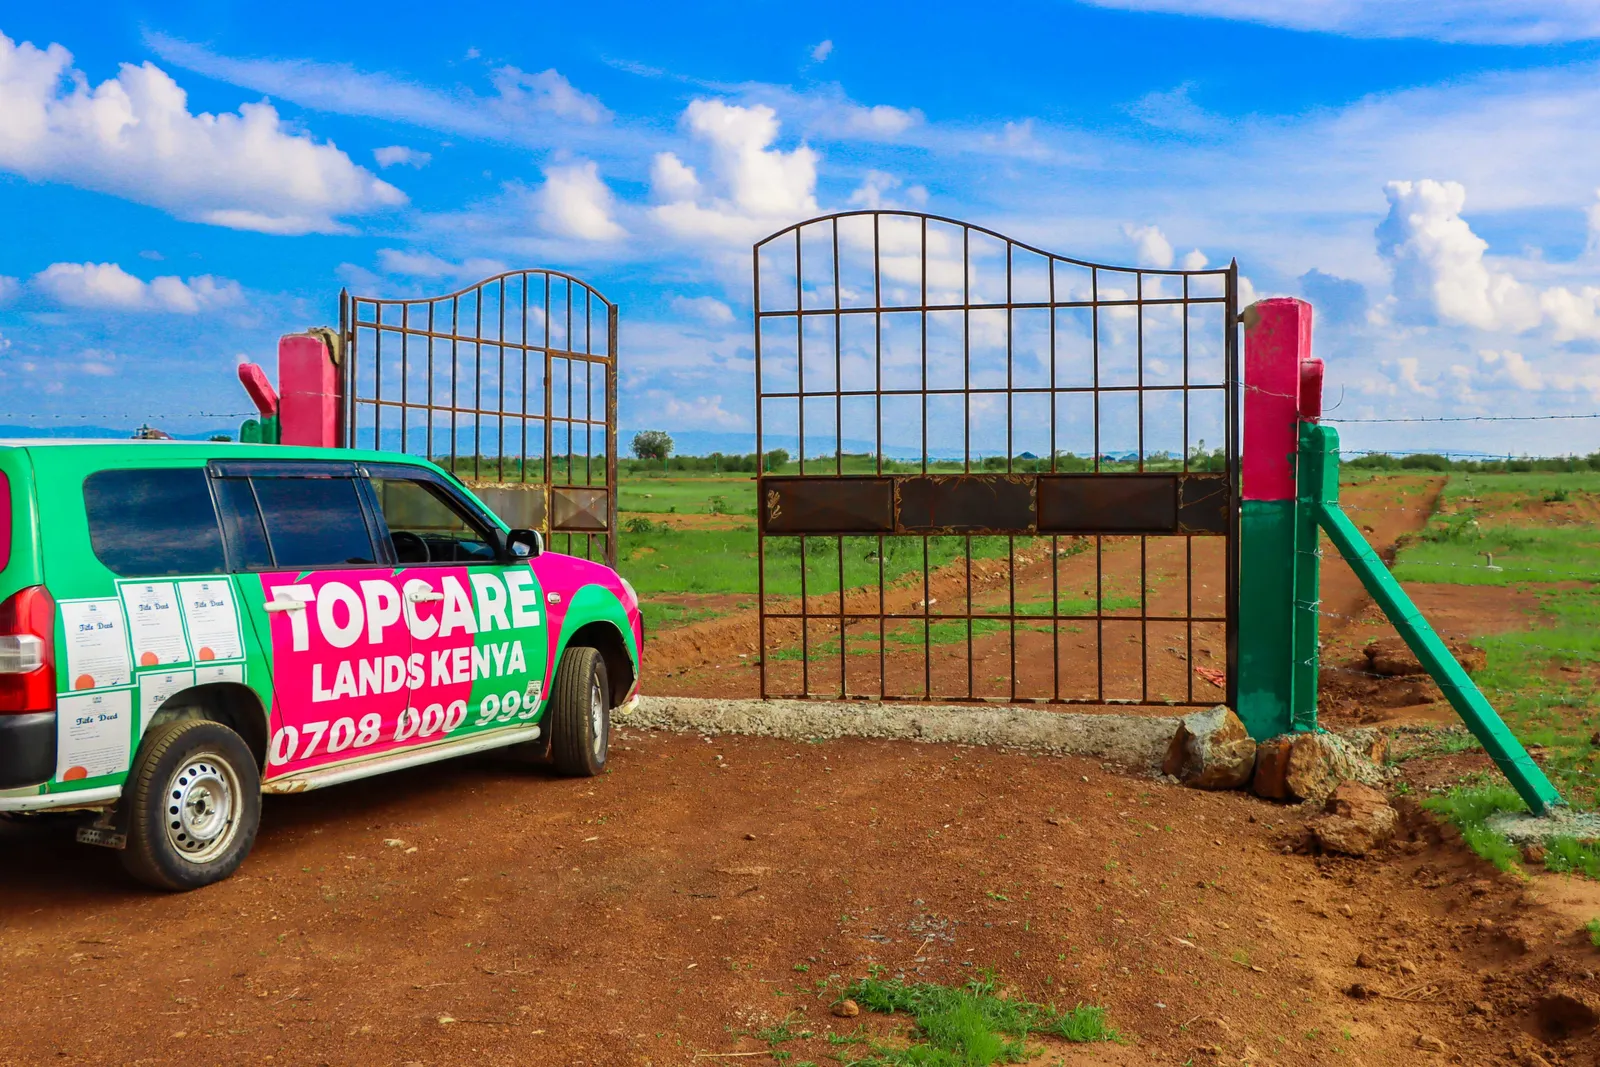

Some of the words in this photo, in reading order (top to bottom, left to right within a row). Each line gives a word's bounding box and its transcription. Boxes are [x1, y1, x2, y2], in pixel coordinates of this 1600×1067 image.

[270, 569, 540, 652] TOPCARE
[312, 653, 425, 702] LANDS
[431, 640, 527, 687] KENYA
[269, 713, 382, 766] 0708
[393, 699, 467, 742] 000
[475, 690, 542, 726] 999
